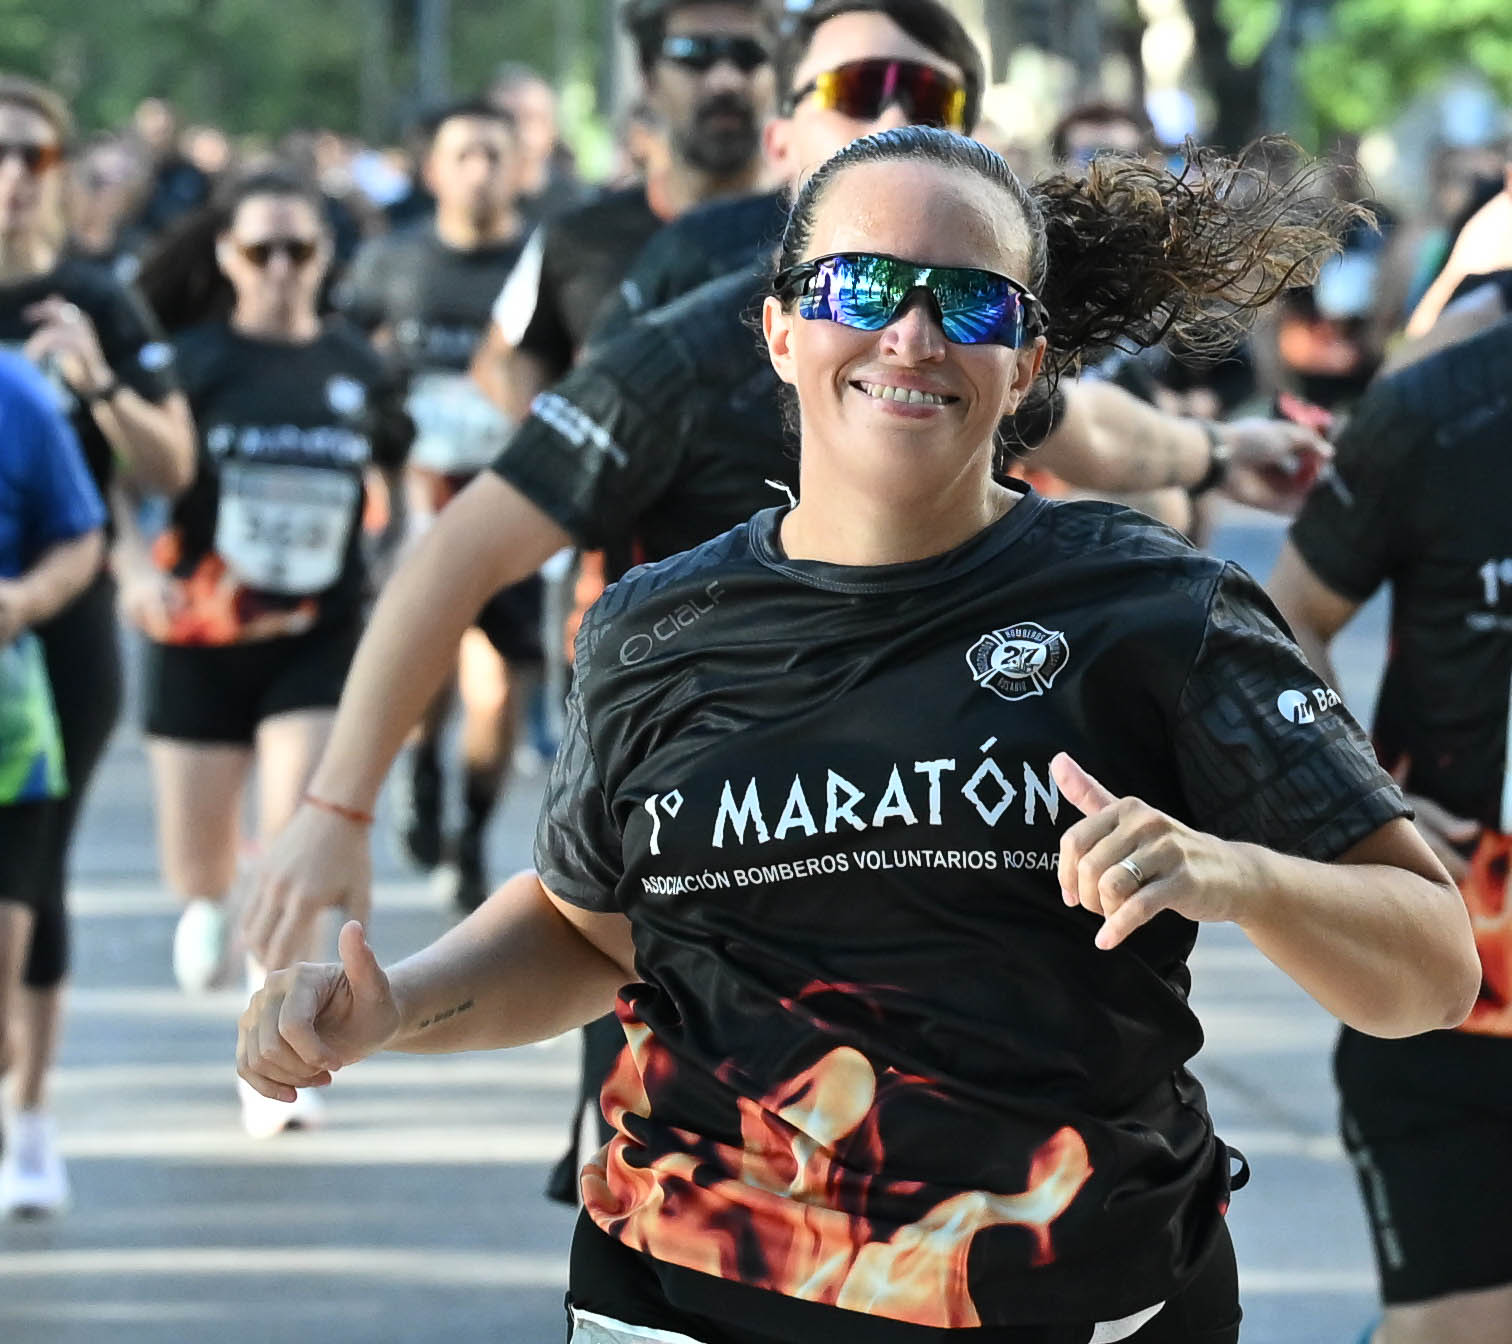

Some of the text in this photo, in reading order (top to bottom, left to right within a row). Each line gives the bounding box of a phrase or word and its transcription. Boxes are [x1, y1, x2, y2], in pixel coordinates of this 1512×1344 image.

[1000, 645, 1040, 666] 27
[711, 736, 1060, 849] MARATÓN
[641, 849, 1061, 897] ASOCIACIÓN BOMBEROS VOLUNTARIOS ROSAR
